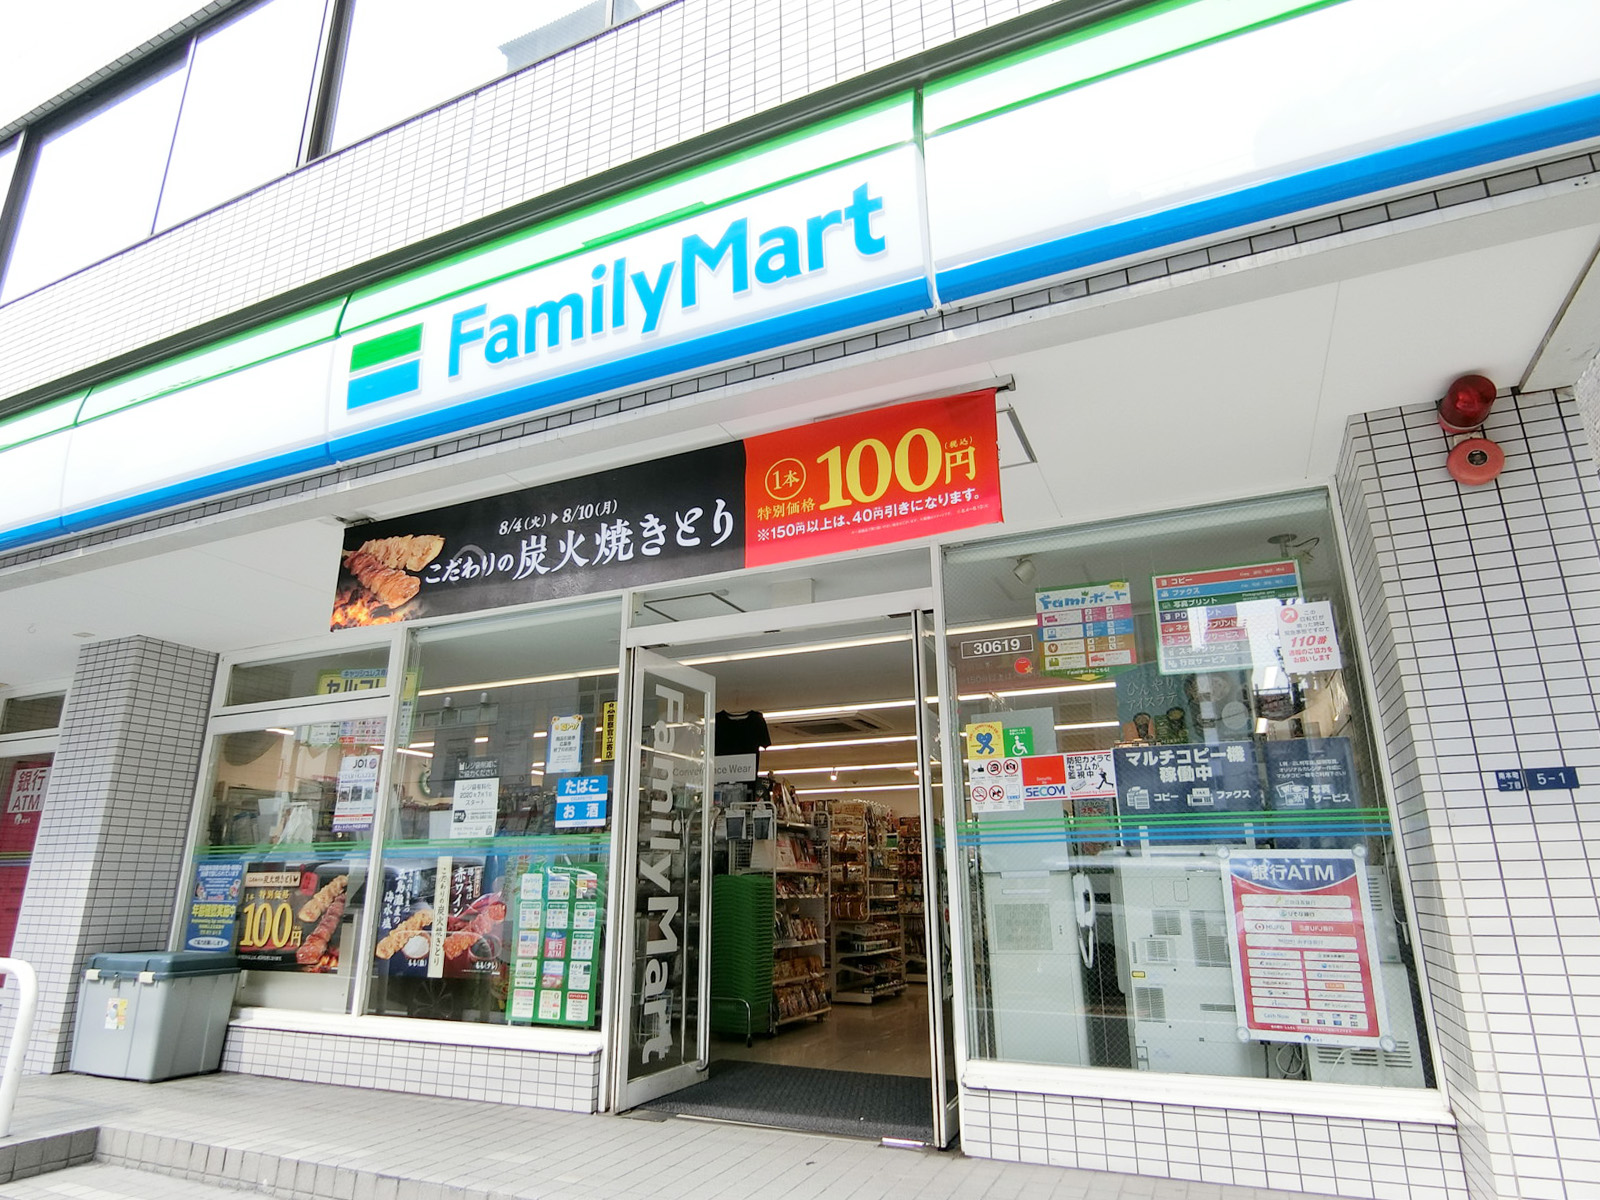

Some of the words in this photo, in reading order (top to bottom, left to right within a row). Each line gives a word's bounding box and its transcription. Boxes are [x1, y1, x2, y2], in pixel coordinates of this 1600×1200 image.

[447, 181, 888, 379] FamilyMart
[772, 469, 801, 491] 1本
[757, 497, 816, 521] 特別価格
[1172, 587, 1201, 596] ファクス
[1173, 597, 1218, 608] 写真プリント
[973, 638, 1021, 655] 30619
[1290, 635, 1327, 648] 110番
[1066, 754, 1112, 765] 防犯カメラで
[1125, 746, 1246, 767] マルチコピー機
[352, 758, 368, 769] JO1
[728, 764, 752, 775] Wear
[1067, 762, 1100, 772] セコムが
[16, 769, 48, 792] 銀行
[1067, 770, 1094, 779] 監視中
[1159, 765, 1213, 783] 稼働中
[1536, 772, 1566, 785] 5-1
[564, 779, 600, 795] たばこ
[1025, 785, 1066, 798] SECOM
[1310, 784, 1331, 794] 写真
[1500, 781, 1522, 789] 一丁目
[1153, 792, 1179, 802] コピー
[1215, 789, 1252, 800] ファクス
[1312, 793, 1351, 804] サービス
[11, 794, 42, 812] ATM
[639, 683, 685, 1065] FamilyMart
[1250, 864, 1335, 881] 銀行ATM
[453, 866, 468, 917] 赤ワイン
[547, 950, 562, 959] ATM
